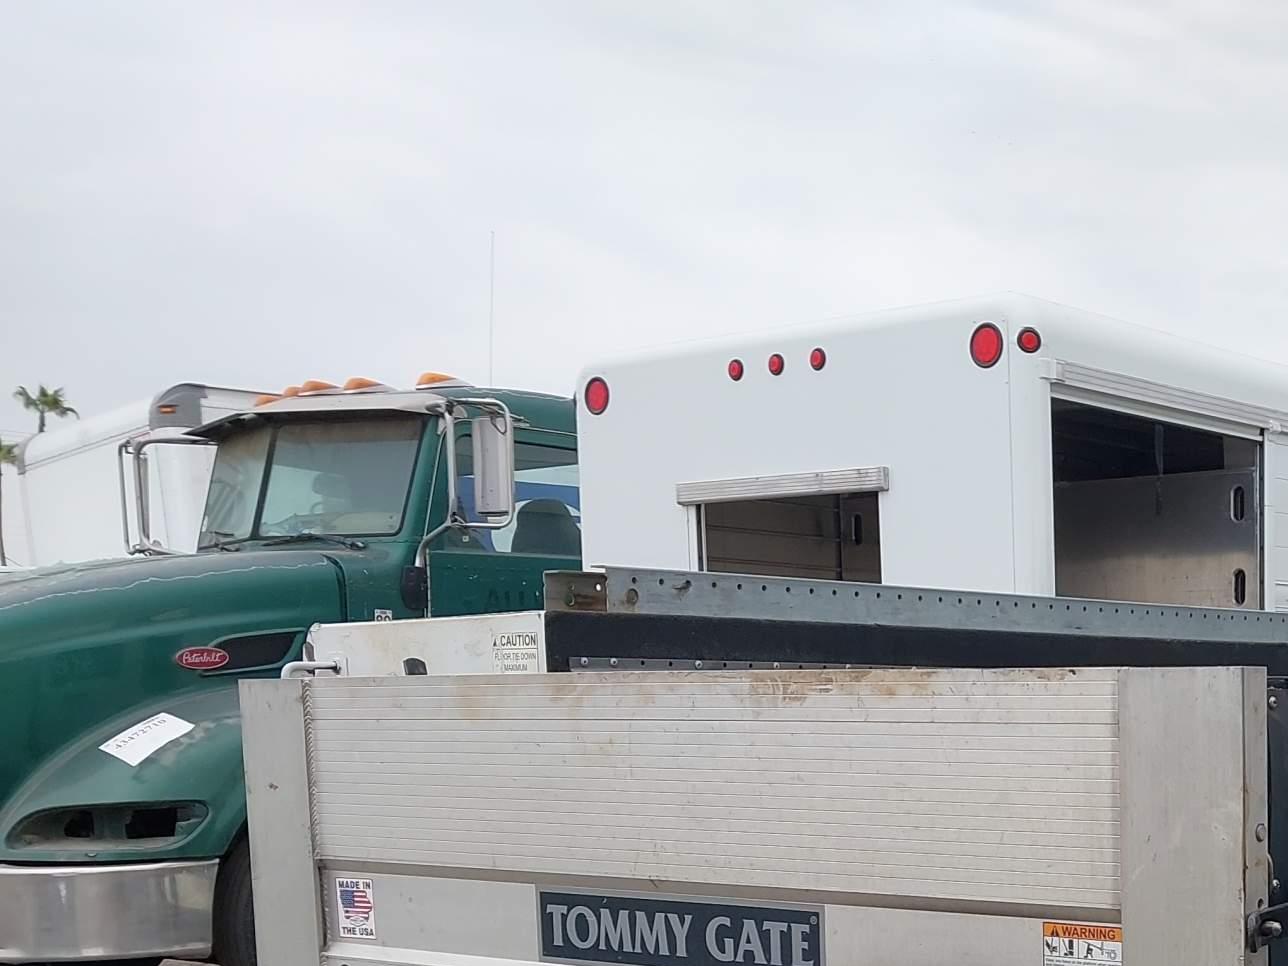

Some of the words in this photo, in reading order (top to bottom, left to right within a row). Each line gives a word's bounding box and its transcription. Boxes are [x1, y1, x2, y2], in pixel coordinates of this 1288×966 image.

[500, 633, 536, 647] CAUTION
[338, 880, 360, 889] MADE
[362, 881, 371, 890] IN
[342, 926, 357, 936] THE
[358, 927, 374, 936] USA
[546, 904, 692, 957] TOMMY
[1061, 925, 1116, 940] WARNING
